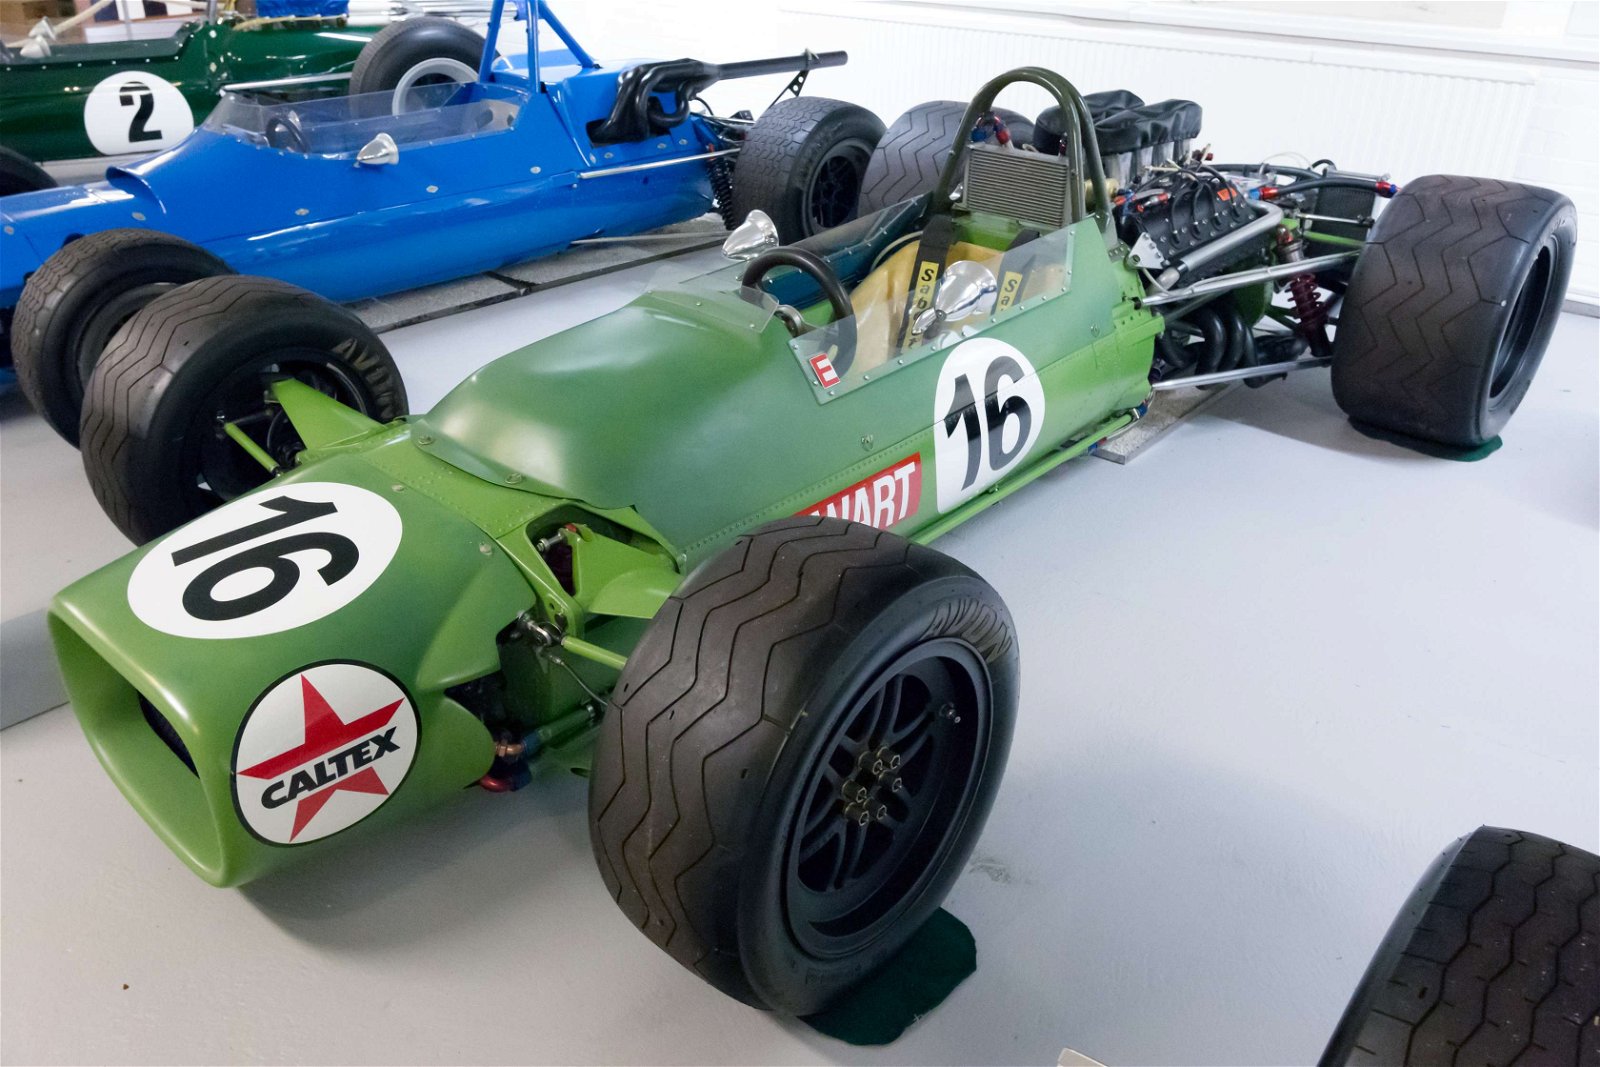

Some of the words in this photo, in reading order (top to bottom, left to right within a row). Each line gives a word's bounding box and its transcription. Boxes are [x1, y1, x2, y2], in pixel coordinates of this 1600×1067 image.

[119, 81, 163, 143] 2
[809, 353, 841, 389] E
[943, 355, 1032, 492] 16
[171, 495, 360, 622] 16
[261, 726, 401, 810] CALTEX
